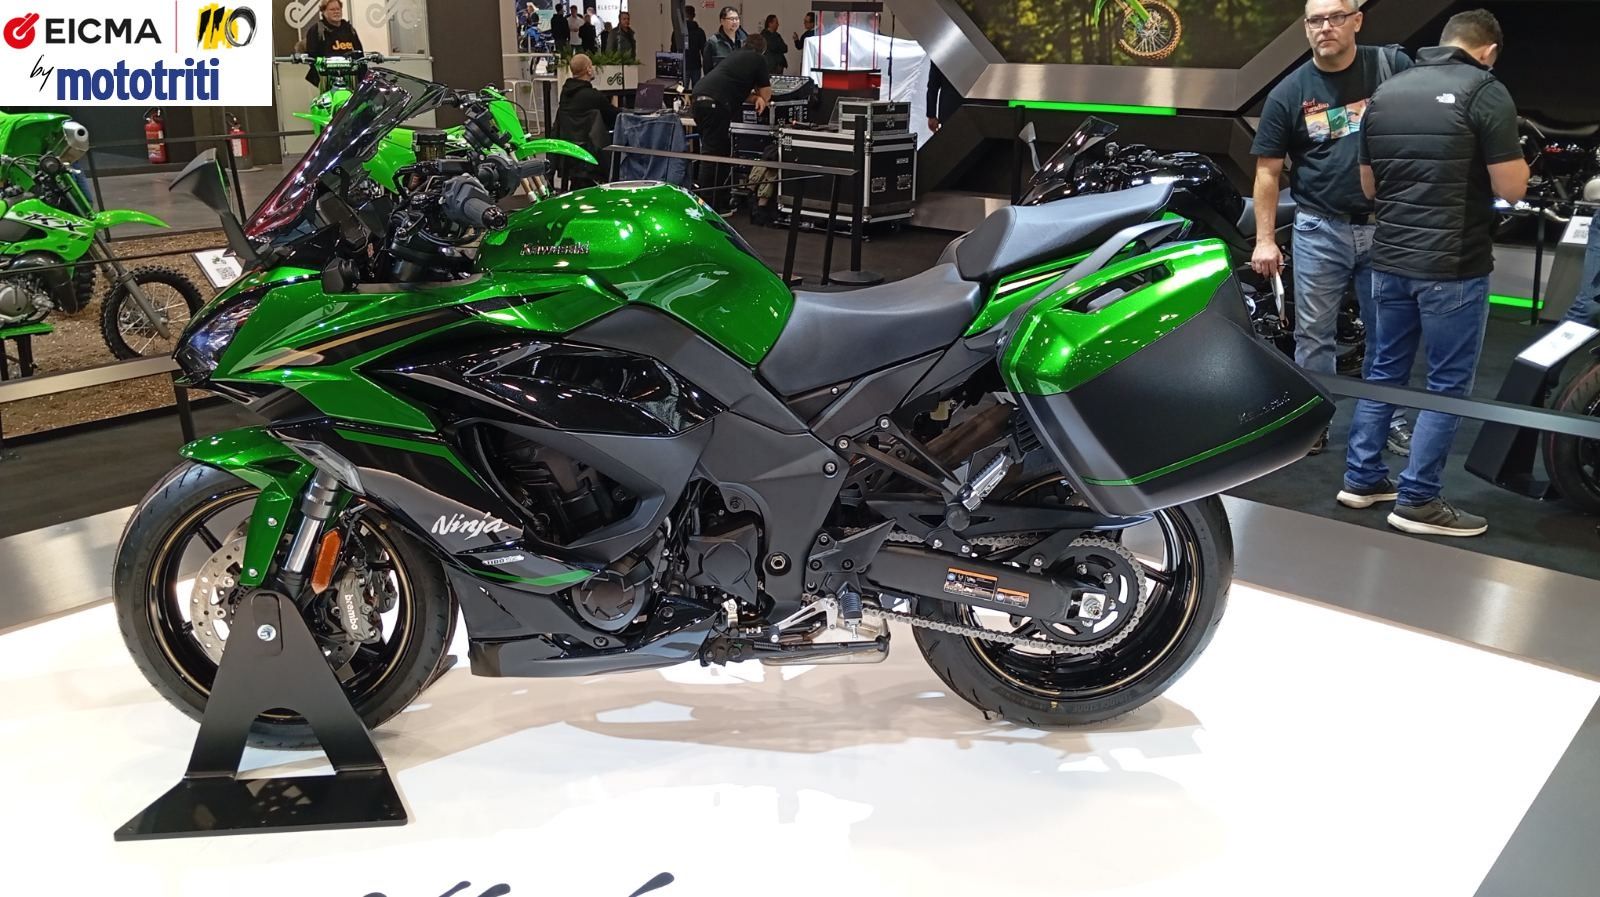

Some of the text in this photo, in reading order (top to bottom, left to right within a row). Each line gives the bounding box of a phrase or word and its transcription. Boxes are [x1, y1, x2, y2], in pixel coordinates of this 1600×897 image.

[332, 40, 353, 50] Jee
[431, 511, 510, 541] Ninja
[344, 593, 359, 631] brembo
